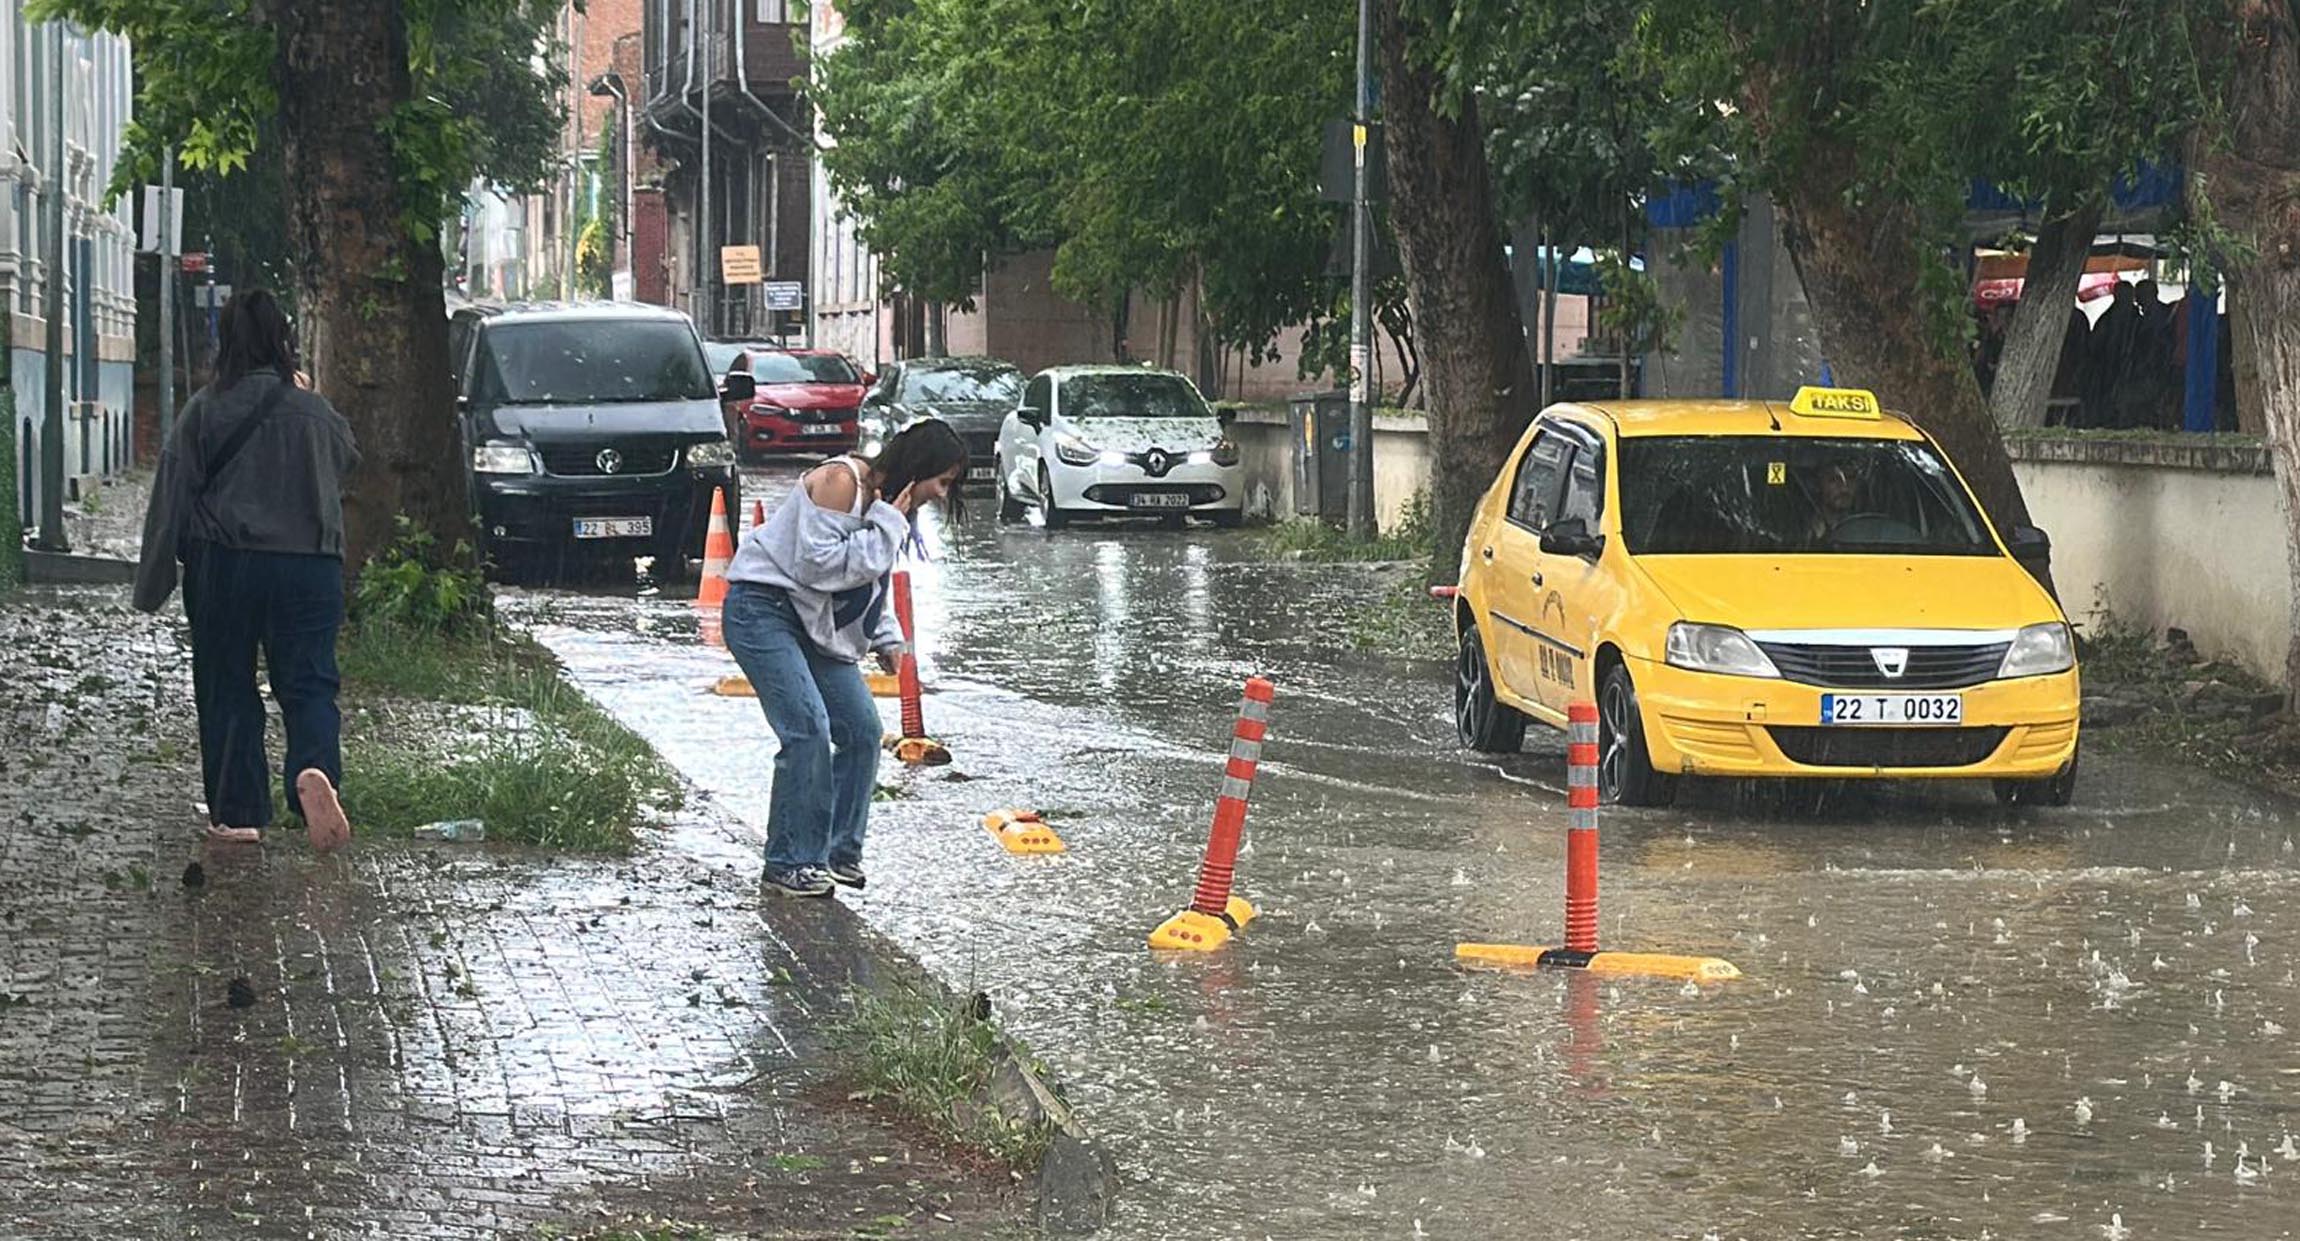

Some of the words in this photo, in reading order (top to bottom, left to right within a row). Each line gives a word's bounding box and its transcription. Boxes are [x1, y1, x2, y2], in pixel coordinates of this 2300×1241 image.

[583, 522, 598, 536] 22
[626, 521, 650, 534] 395
[1835, 698, 1862, 720] 22
[1875, 698, 1888, 720] T
[1903, 698, 1959, 720] 0032
